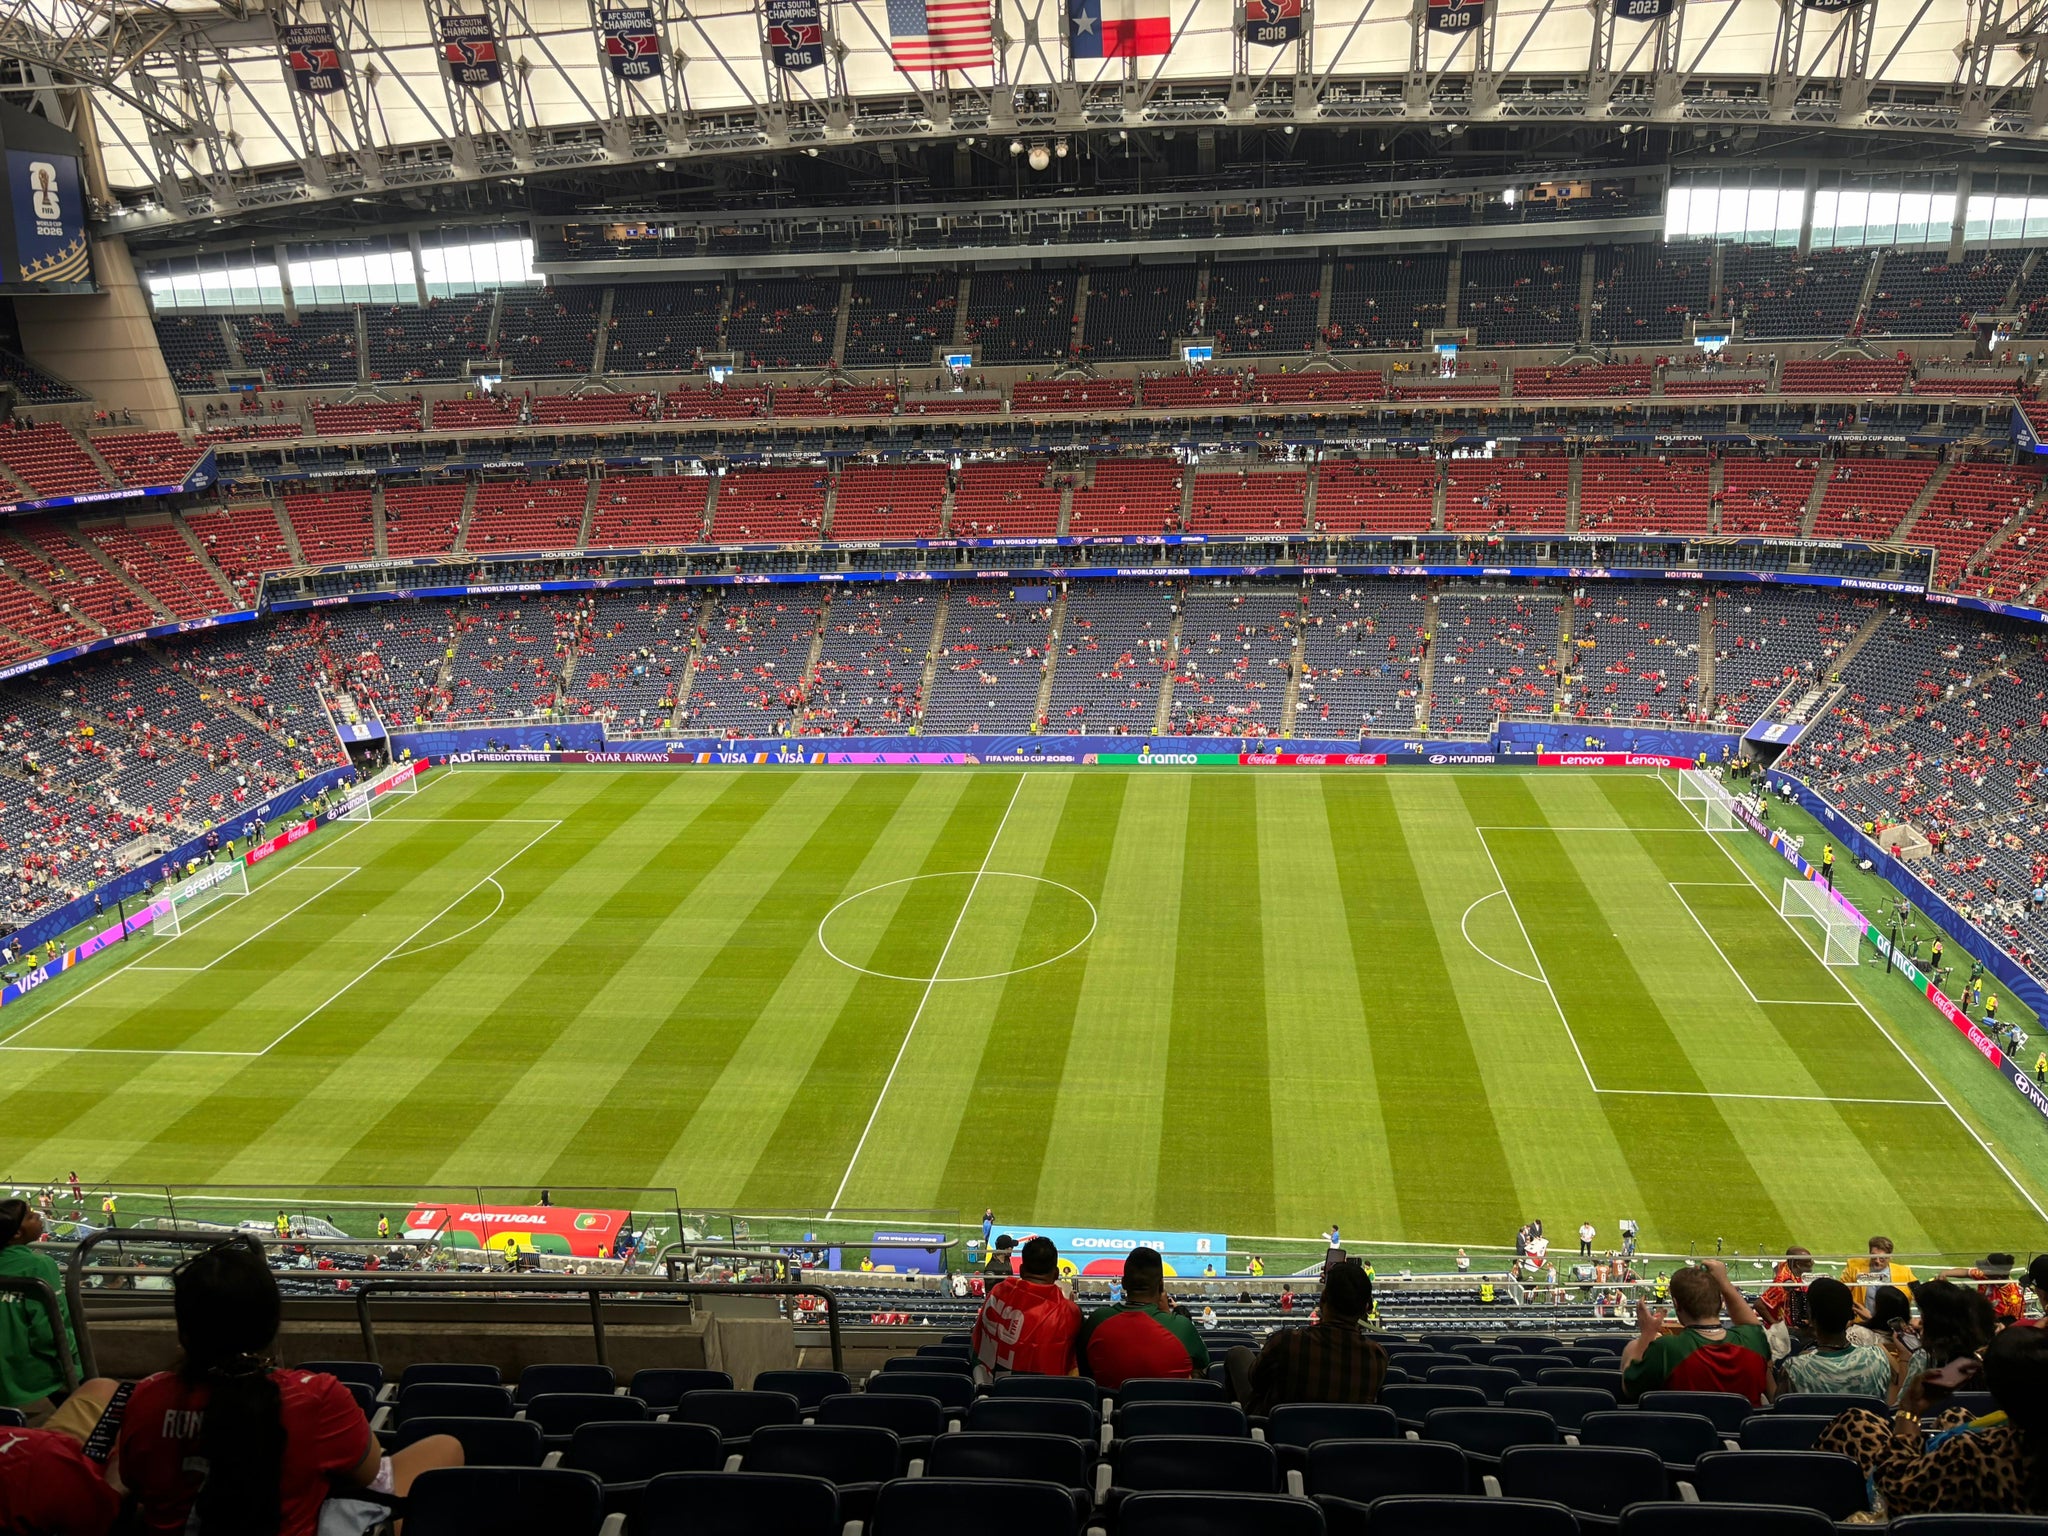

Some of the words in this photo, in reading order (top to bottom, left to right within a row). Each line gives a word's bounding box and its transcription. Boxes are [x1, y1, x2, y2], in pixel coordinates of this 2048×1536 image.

[787, 0, 810, 8] SOUTH
[1628, 0, 1660, 14] 2023
[622, 11, 646, 19] SOUTH
[768, 8, 817, 19] CHAMPIONS
[1440, 12, 1470, 27] 2019
[446, 19, 459, 27] AFC
[460, 18, 482, 26] SOUTH
[604, 18, 652, 30] CHAMPIONS
[303, 26, 326, 35] SOUTH
[442, 26, 489, 37] CHAMPIONS
[1258, 26, 1286, 40] 2018
[286, 34, 332, 45] CHAMPIONS
[784, 52, 812, 65] 2016
[622, 62, 650, 75] 2015
[462, 68, 489, 82] 2012
[309, 75, 332, 89] 2011
[37, 227, 63, 236] 2026
[1858, 581, 1887, 590] WORLD
[1888, 583, 1904, 591] CUP
[313, 597, 349, 606] HOUSTON
[114, 632, 147, 645] HOUSTON
[16, 665, 27, 674] CUP
[28, 658, 49, 670] 2026
[586, 753, 621, 763] QATAR
[625, 753, 669, 762] AIRWAYS
[717, 753, 748, 763] VISA
[774, 753, 804, 763] VISA
[1137, 754, 1198, 764] aramco
[1560, 755, 1604, 765] Lenovo
[1626, 754, 1670, 767] Lenovo
[391, 768, 414, 787] Lenovo
[257, 804, 270, 816] FIFA
[1825, 807, 1834, 821] FIFA
[1783, 842, 1798, 868] VISA
[185, 864, 233, 898] aramco
[14, 966, 49, 994] VISA
[459, 1212, 547, 1224] PORTUGAL
[1072, 1238, 1136, 1248] CONGO
[1140, 1240, 1164, 1250] DR
